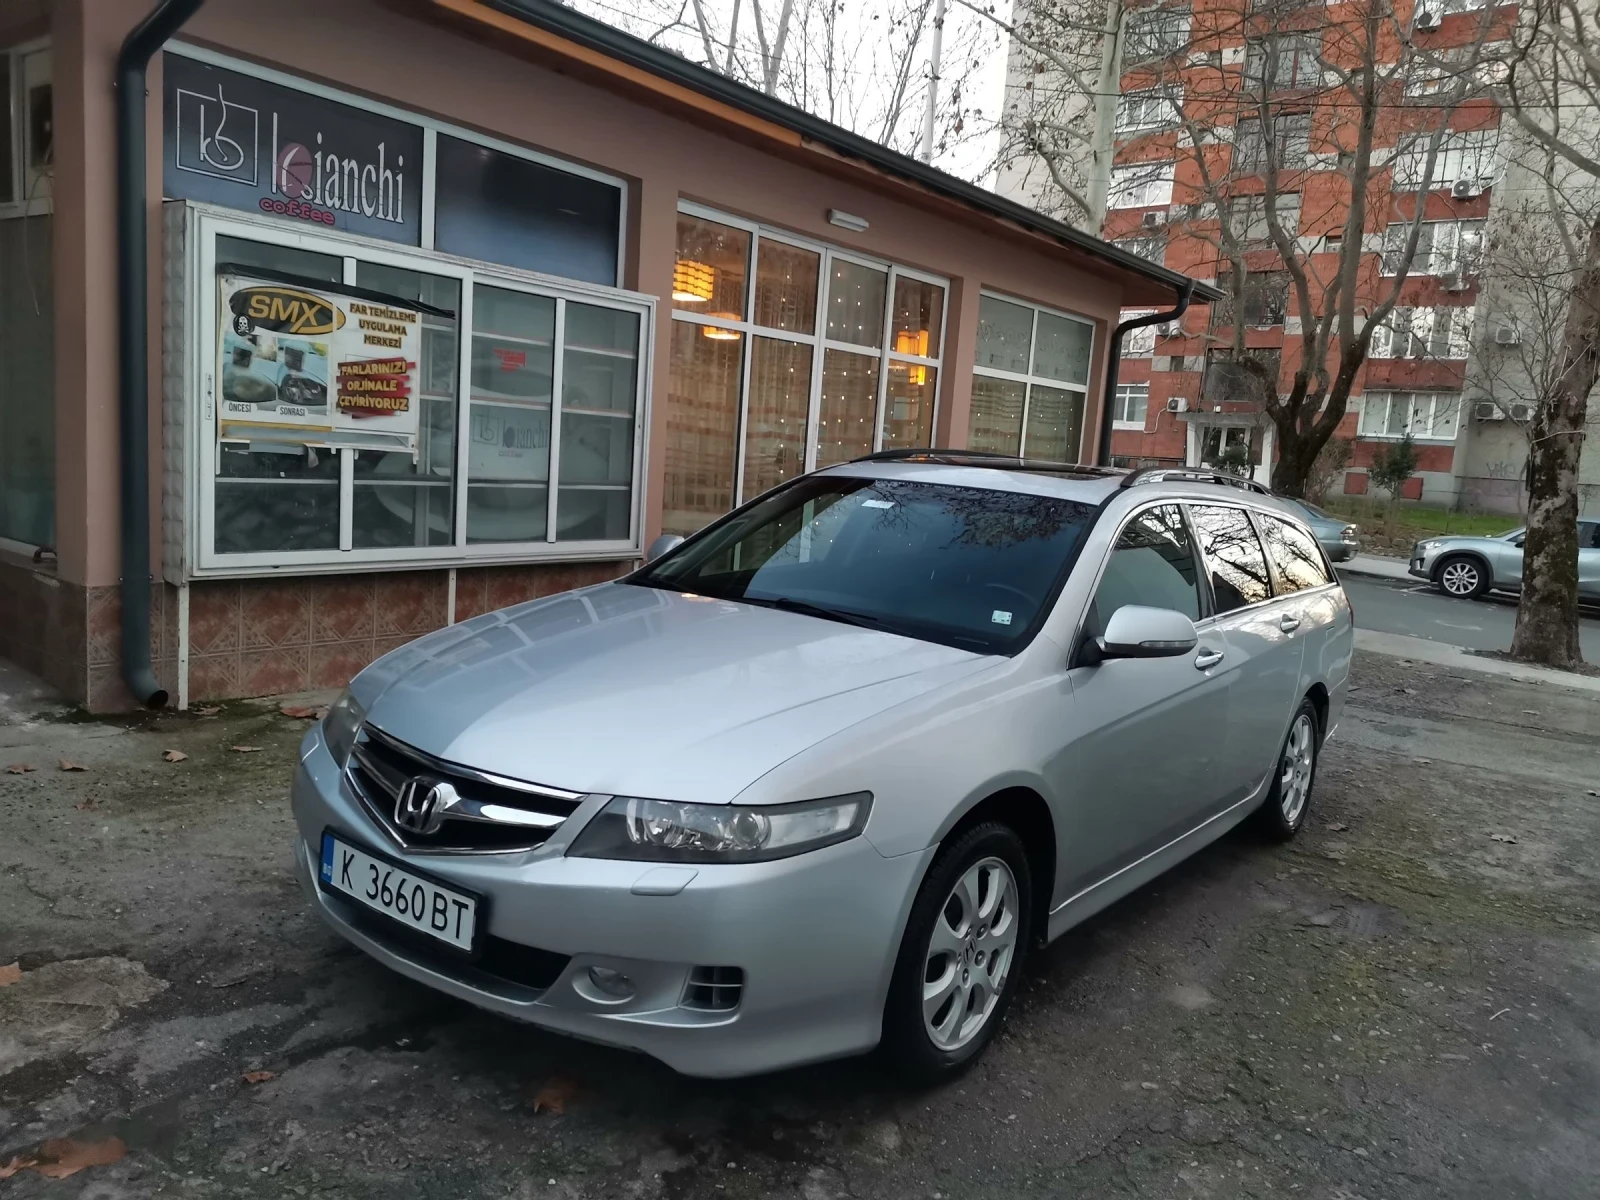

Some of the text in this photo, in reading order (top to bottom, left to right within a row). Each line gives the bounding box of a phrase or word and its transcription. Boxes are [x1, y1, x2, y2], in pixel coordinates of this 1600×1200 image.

[259, 197, 336, 226] coffee
[247, 294, 322, 334] SMX
[349, 302, 417, 324] FAR TEMİZLEME
[358, 318, 408, 337] UYGULAMA
[363, 334, 402, 349] MERKEZİ
[341, 360, 407, 376] FARLARINIZI
[346, 378, 398, 392] ORJİNALE
[338, 393, 409, 412] ÇEVİRİYORUZ
[341, 849, 355, 891] K
